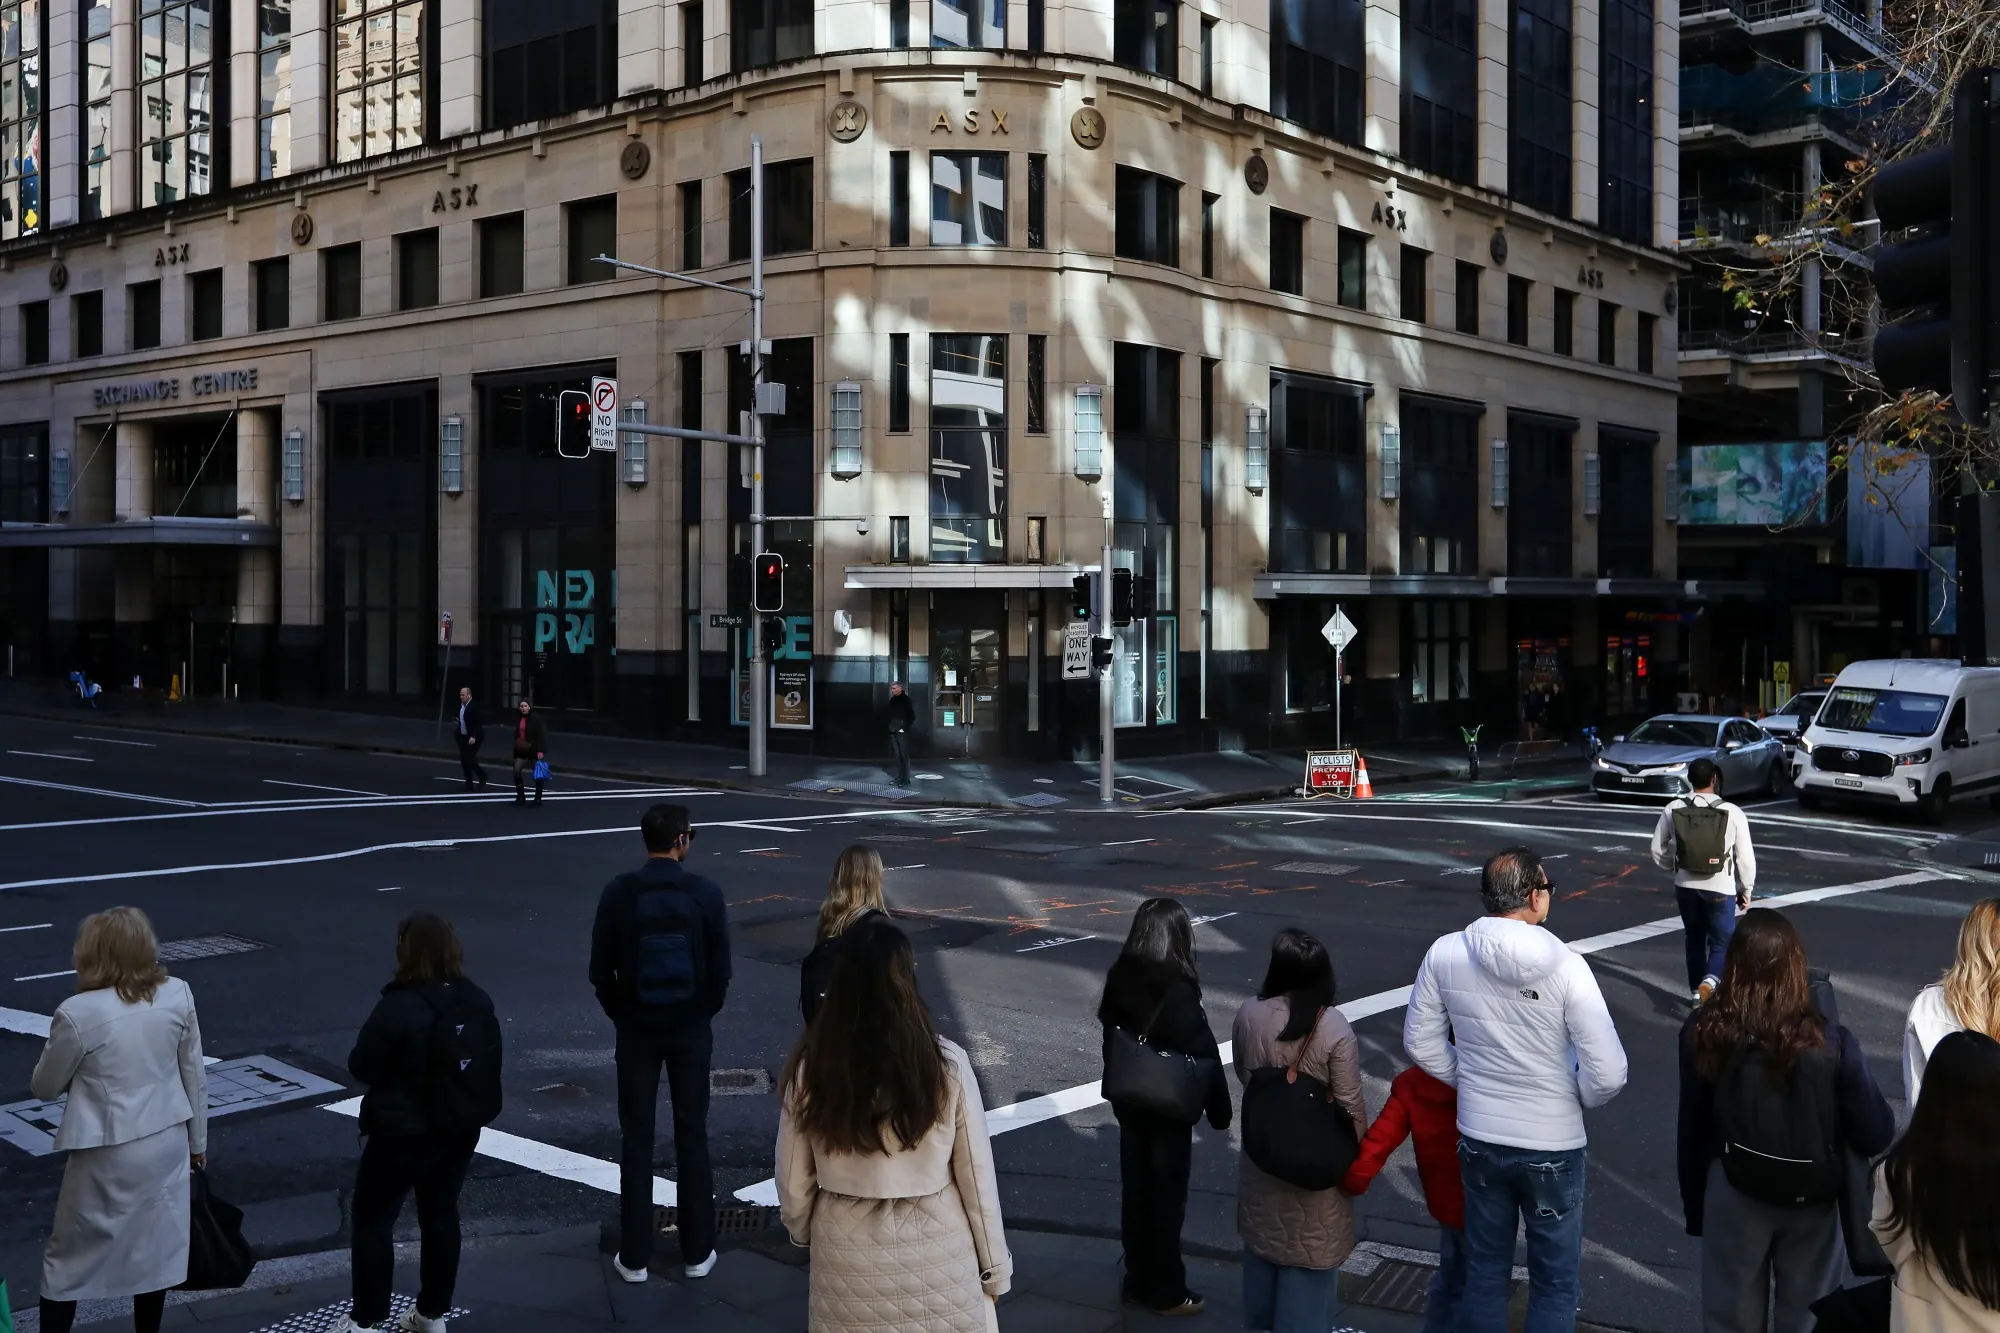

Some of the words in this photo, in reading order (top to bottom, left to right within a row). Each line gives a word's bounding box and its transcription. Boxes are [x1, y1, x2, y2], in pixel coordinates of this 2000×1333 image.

[929, 107, 1009, 133] ASX
[431, 183, 479, 213] ASX
[1371, 201, 1407, 232] ASX
[155, 243, 190, 267] ASX
[1577, 264, 1604, 289] ASX
[93, 378, 180, 408] EXCHANGE
[192, 367, 259, 397] CENTRE
[597, 415, 612, 426] NO
[594, 428, 614, 437] RIGHT
[595, 438, 614, 447] TURN
[719, 615, 736, 625] Bridge
[736, 616, 742, 624] St
[1069, 638, 1087, 648] ONE
[1066, 651, 1088, 662] WAY
[1312, 756, 1351, 765] CYCLISTS
